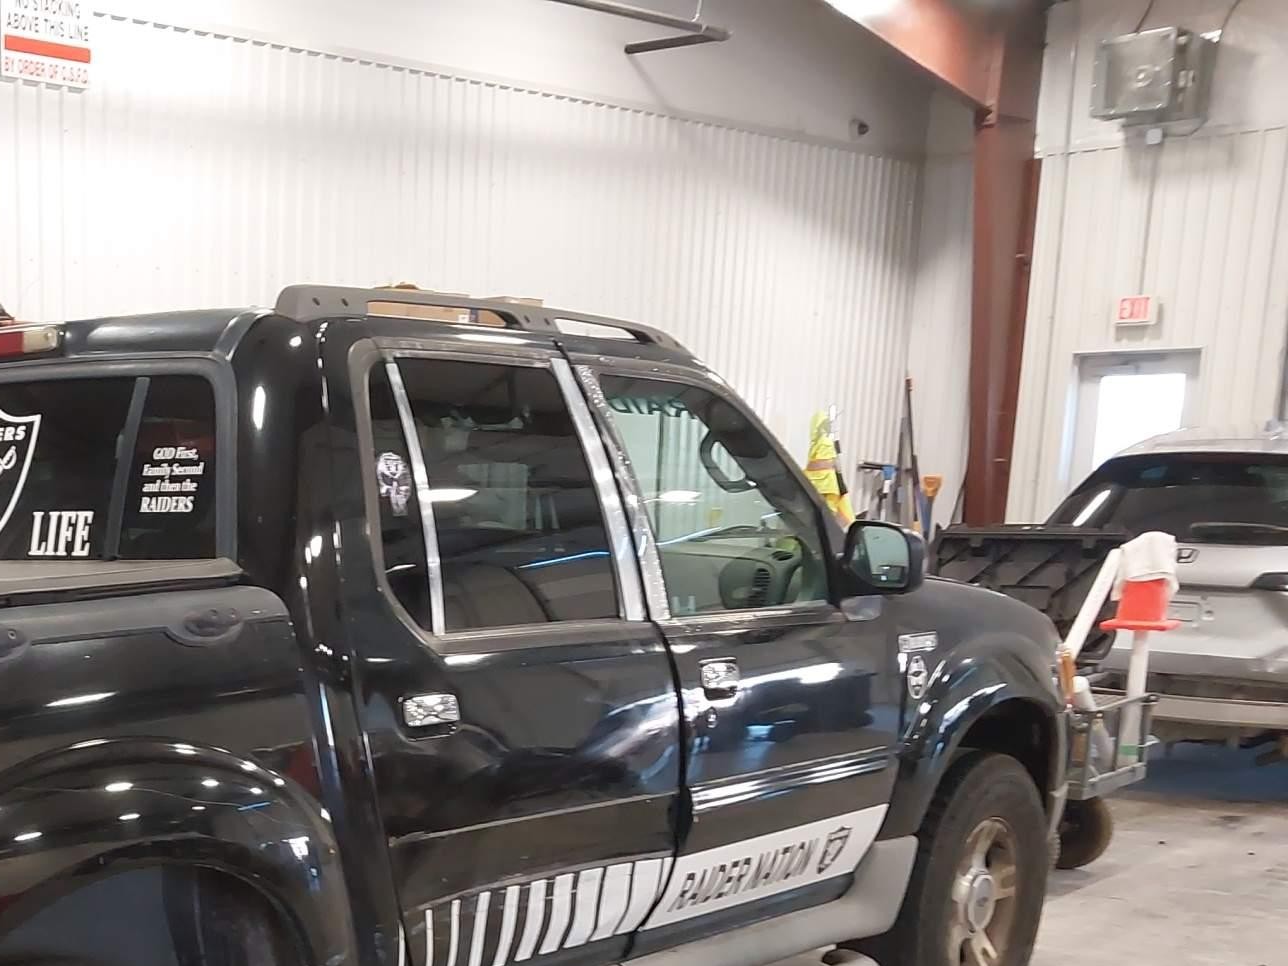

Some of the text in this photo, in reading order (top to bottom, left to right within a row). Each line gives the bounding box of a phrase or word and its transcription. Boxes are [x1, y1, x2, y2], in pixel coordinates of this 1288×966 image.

[6, 11, 89, 42] ABOVE THIS LINE
[4, 56, 15, 72] BY
[18, 58, 46, 77] ORDER
[139, 496, 195, 513] RAIDERS
[27, 511, 95, 557] LIFE
[667, 837, 820, 912] RAIDER NATION
